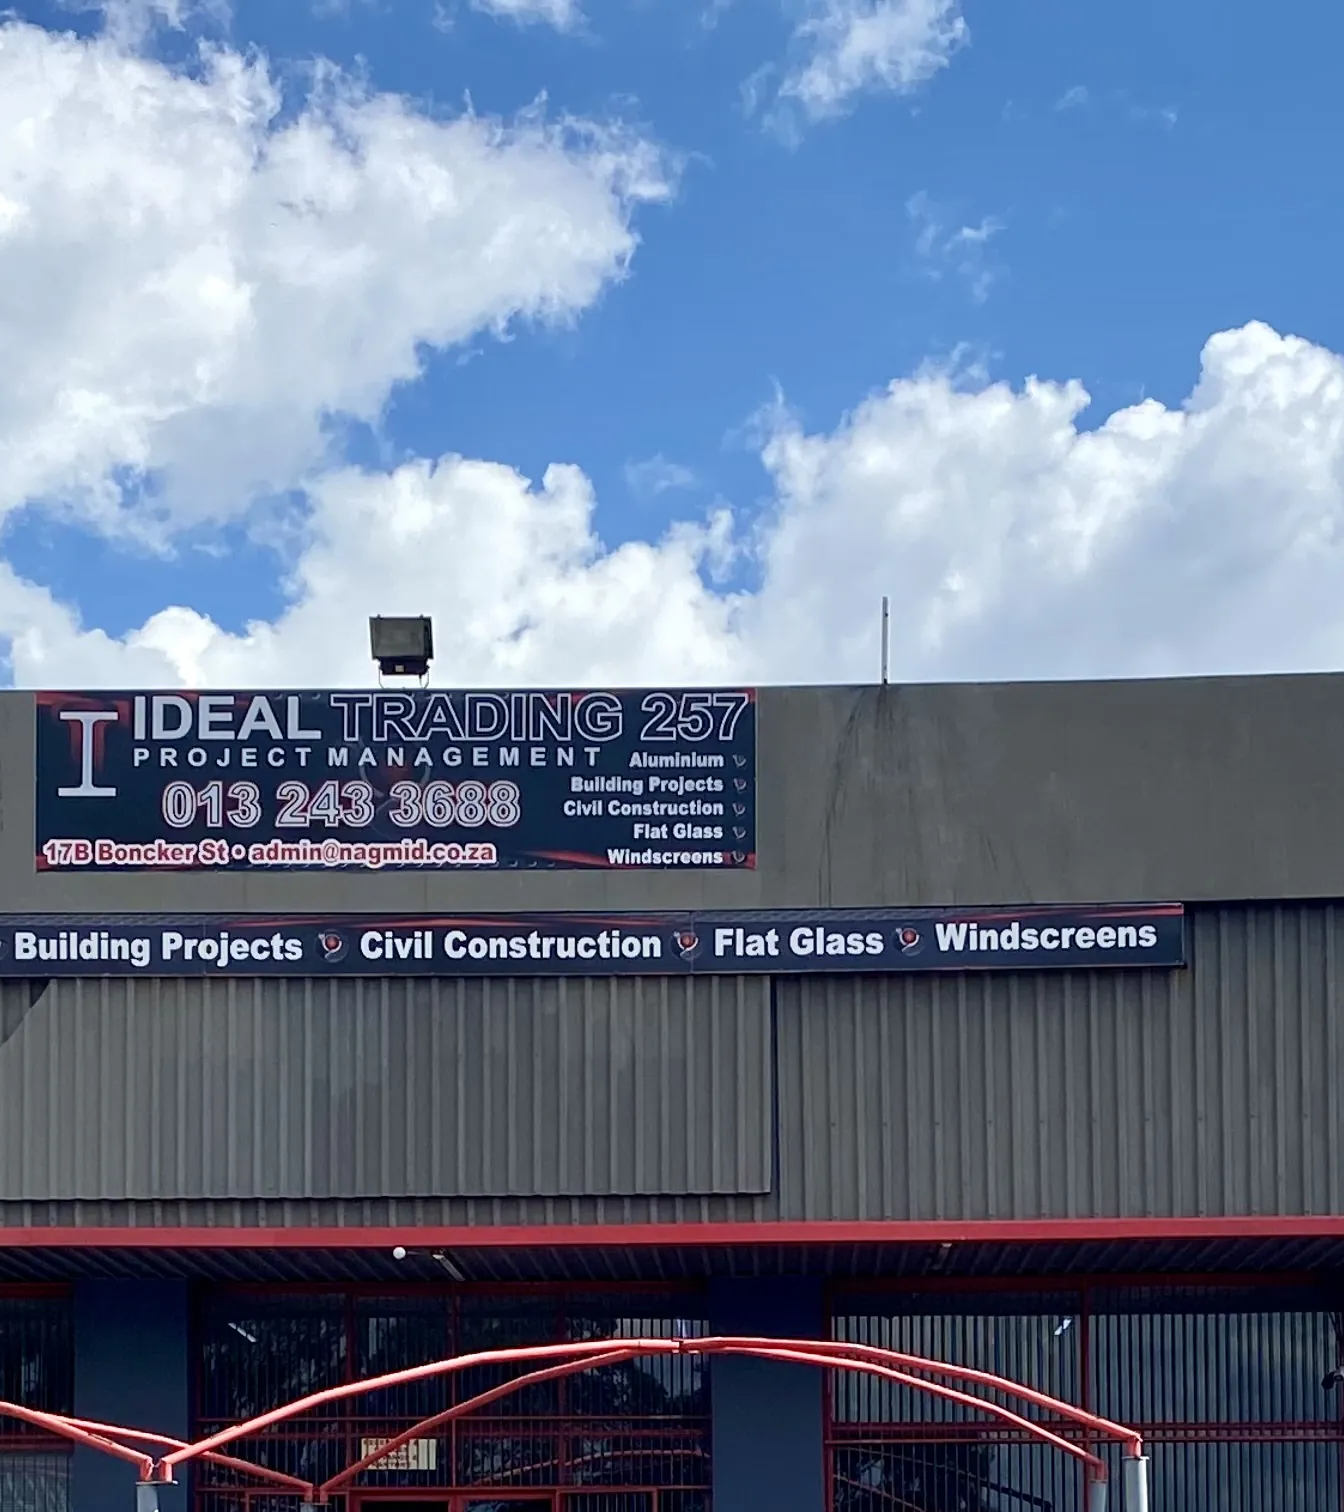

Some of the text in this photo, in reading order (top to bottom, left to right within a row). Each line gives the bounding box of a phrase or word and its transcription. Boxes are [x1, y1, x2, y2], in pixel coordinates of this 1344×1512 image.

[133, 692, 749, 742] IDEAL TRADING 257
[133, 746, 601, 768] PROJECT MANAGEMENT
[629, 751, 724, 768] Aluminium
[570, 775, 724, 796] Building Projects
[162, 780, 521, 828] 013 243 3688
[564, 800, 724, 816] Civil Construction
[633, 823, 723, 839] Flat Glass
[45, 838, 497, 867] 17B Boncker St admin@nagmid.co.za
[608, 849, 724, 865] Windscreens
[15, 931, 150, 967] Building
[162, 931, 303, 967] Projects
[360, 930, 433, 959] Civil
[444, 930, 661, 959] Construction
[714, 927, 779, 957] Flat
[789, 927, 884, 956] Glass
[935, 922, 1157, 952] Windscreens
